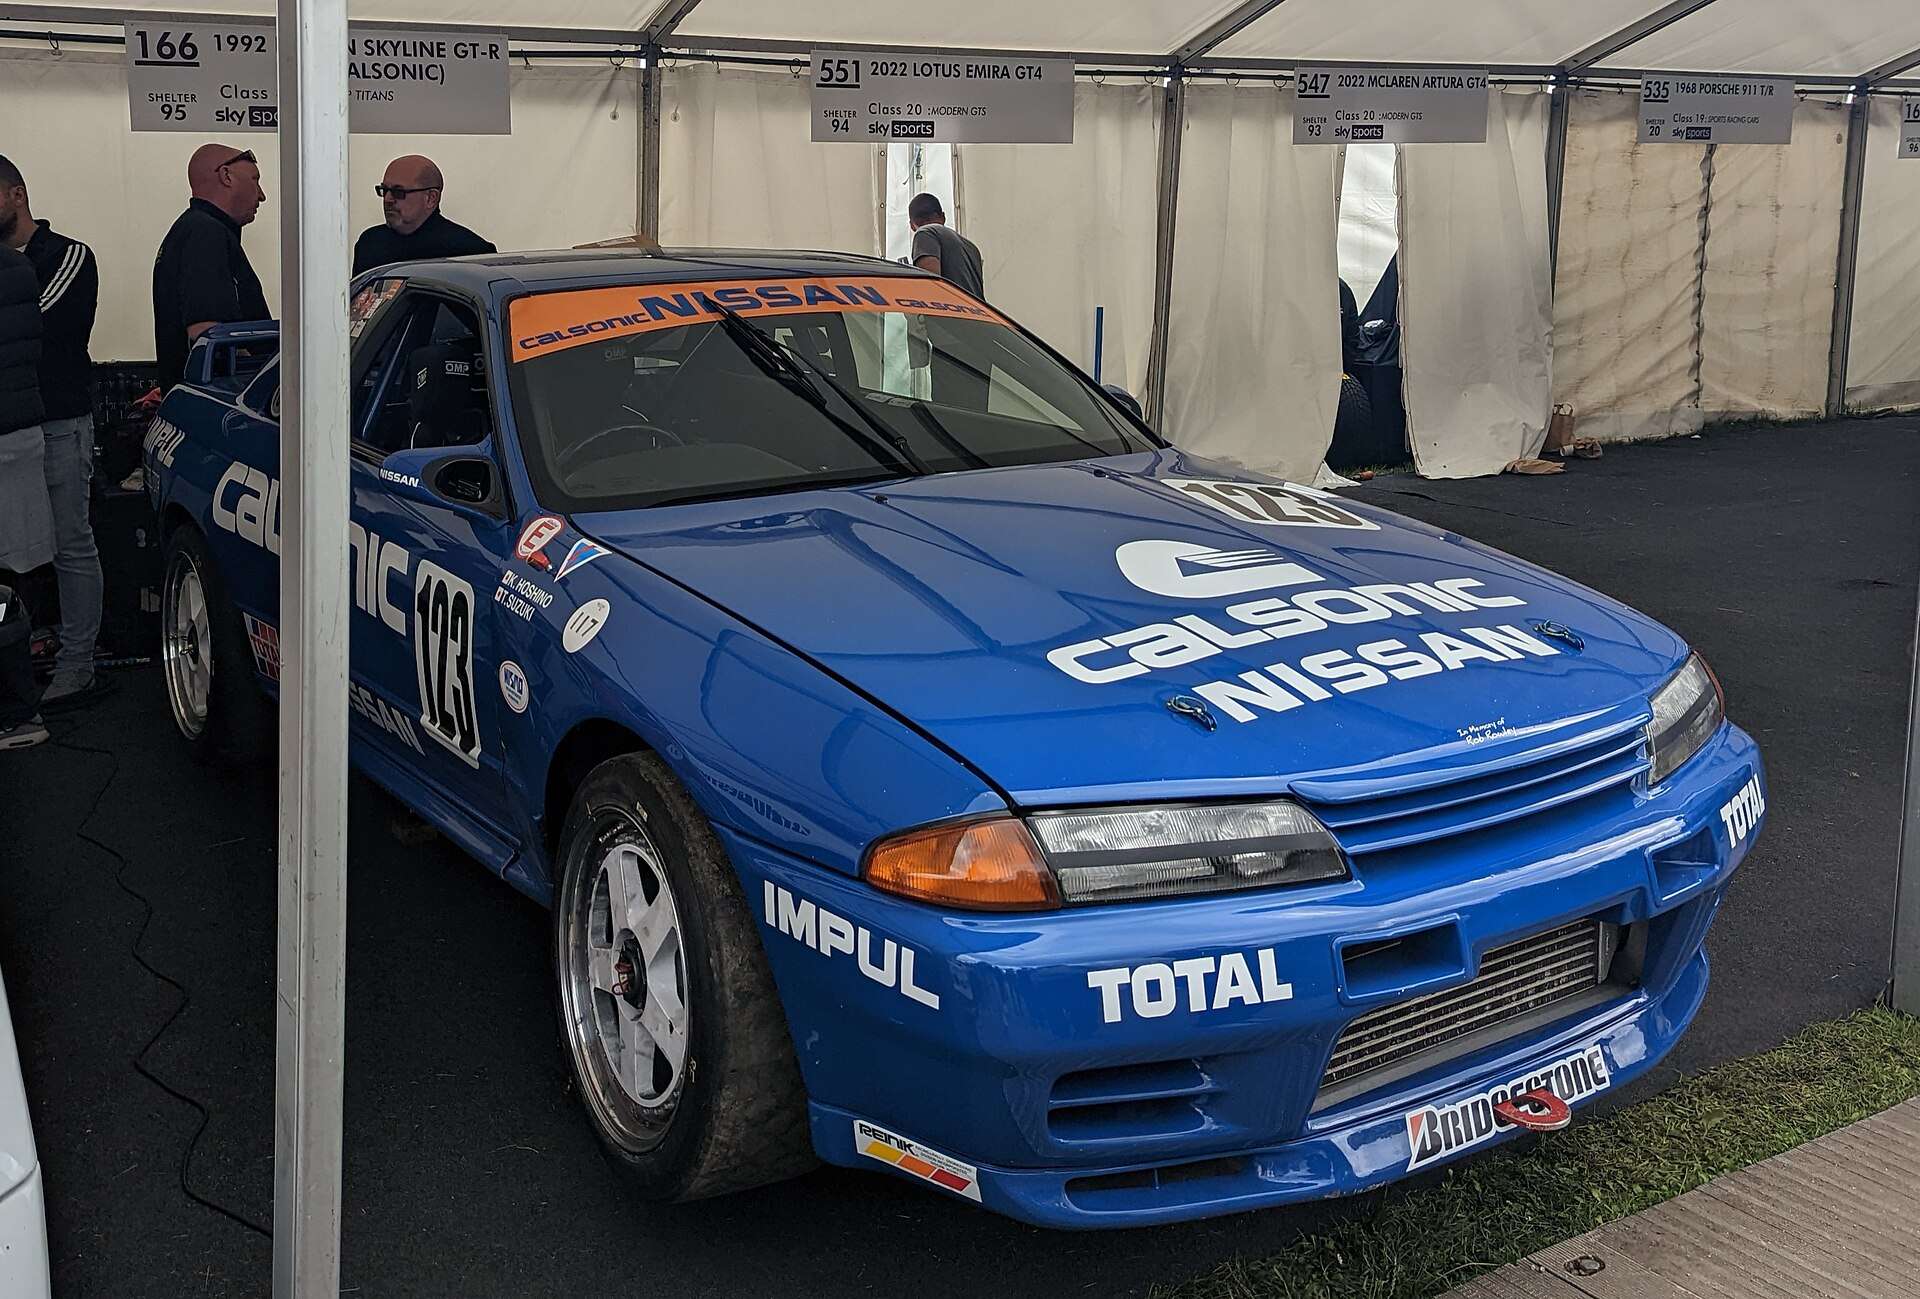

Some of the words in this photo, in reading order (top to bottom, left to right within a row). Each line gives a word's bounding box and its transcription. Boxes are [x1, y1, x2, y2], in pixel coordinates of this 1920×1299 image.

[135, 31, 198, 60] 166
[213, 34, 266, 53] 1992
[364, 39, 446, 58] SKYLINE
[453, 42, 500, 60] GT-R
[348, 62, 445, 85] ALSONIC)
[820, 59, 860, 83] 551
[870, 61, 907, 77] 2022
[913, 62, 961, 78] LOTUS
[966, 63, 1010, 79] EMIRA
[1015, 65, 1042, 81] GT4
[1298, 73, 1330, 94] 547
[1337, 74, 1365, 88] 2022
[1367, 75, 1420, 89] MCLAREN
[1422, 76, 1464, 89] ARTURA
[1466, 77, 1486, 89] GT4
[1643, 81, 1670, 98] 535
[1675, 82, 1697, 94] 1968
[1699, 83, 1740, 95] PORSCHE
[1742, 84, 1757, 95] 911
[1760, 85, 1774, 96] T/R
[148, 92, 198, 103] SHELTER
[219, 84, 268, 99] Class
[356, 89, 394, 101] TITANS
[160, 103, 187, 121] 95
[215, 106, 246, 126] sky
[823, 109, 857, 119] SHELTER
[868, 103, 901, 116] Class
[906, 103, 922, 116] 20
[970, 106, 987, 117] GTS
[1335, 110, 1360, 121] Class
[1363, 110, 1375, 121] 20
[1410, 112, 1423, 121] GTS
[1672, 113, 1693, 123] Class
[1696, 114, 1707, 123] 19:
[831, 118, 850, 133] 94
[1302, 116, 1327, 124] SHELTER
[868, 121, 889, 137] sky
[893, 122, 933, 136] sports
[1307, 125, 1321, 137] 93
[1334, 126, 1350, 139] sky
[1353, 125, 1382, 138] sports
[1649, 125, 1660, 136] 20
[1672, 127, 1685, 139] sky
[1686, 127, 1710, 138] sports
[1909, 142, 1919, 153] 96
[638, 284, 890, 321] NISSAN
[445, 363, 469, 374] OMP
[380, 468, 419, 487] NISSAN
[1181, 483, 1363, 526] 123
[570, 611, 599, 637] 117
[417, 574, 476, 754] 123
[1192, 624, 1561, 723] NISSAN
[1457, 728, 1468, 737] In
[1468, 721, 1497, 733] Memory
[1497, 717, 1504, 726] of
[1466, 732, 1484, 746] Rob
[1720, 773, 1765, 849] TOTAL
[764, 880, 940, 1010] IMPUL
[1087, 948, 1293, 1023] TOTAL
[859, 1122, 915, 1156] REINIK
